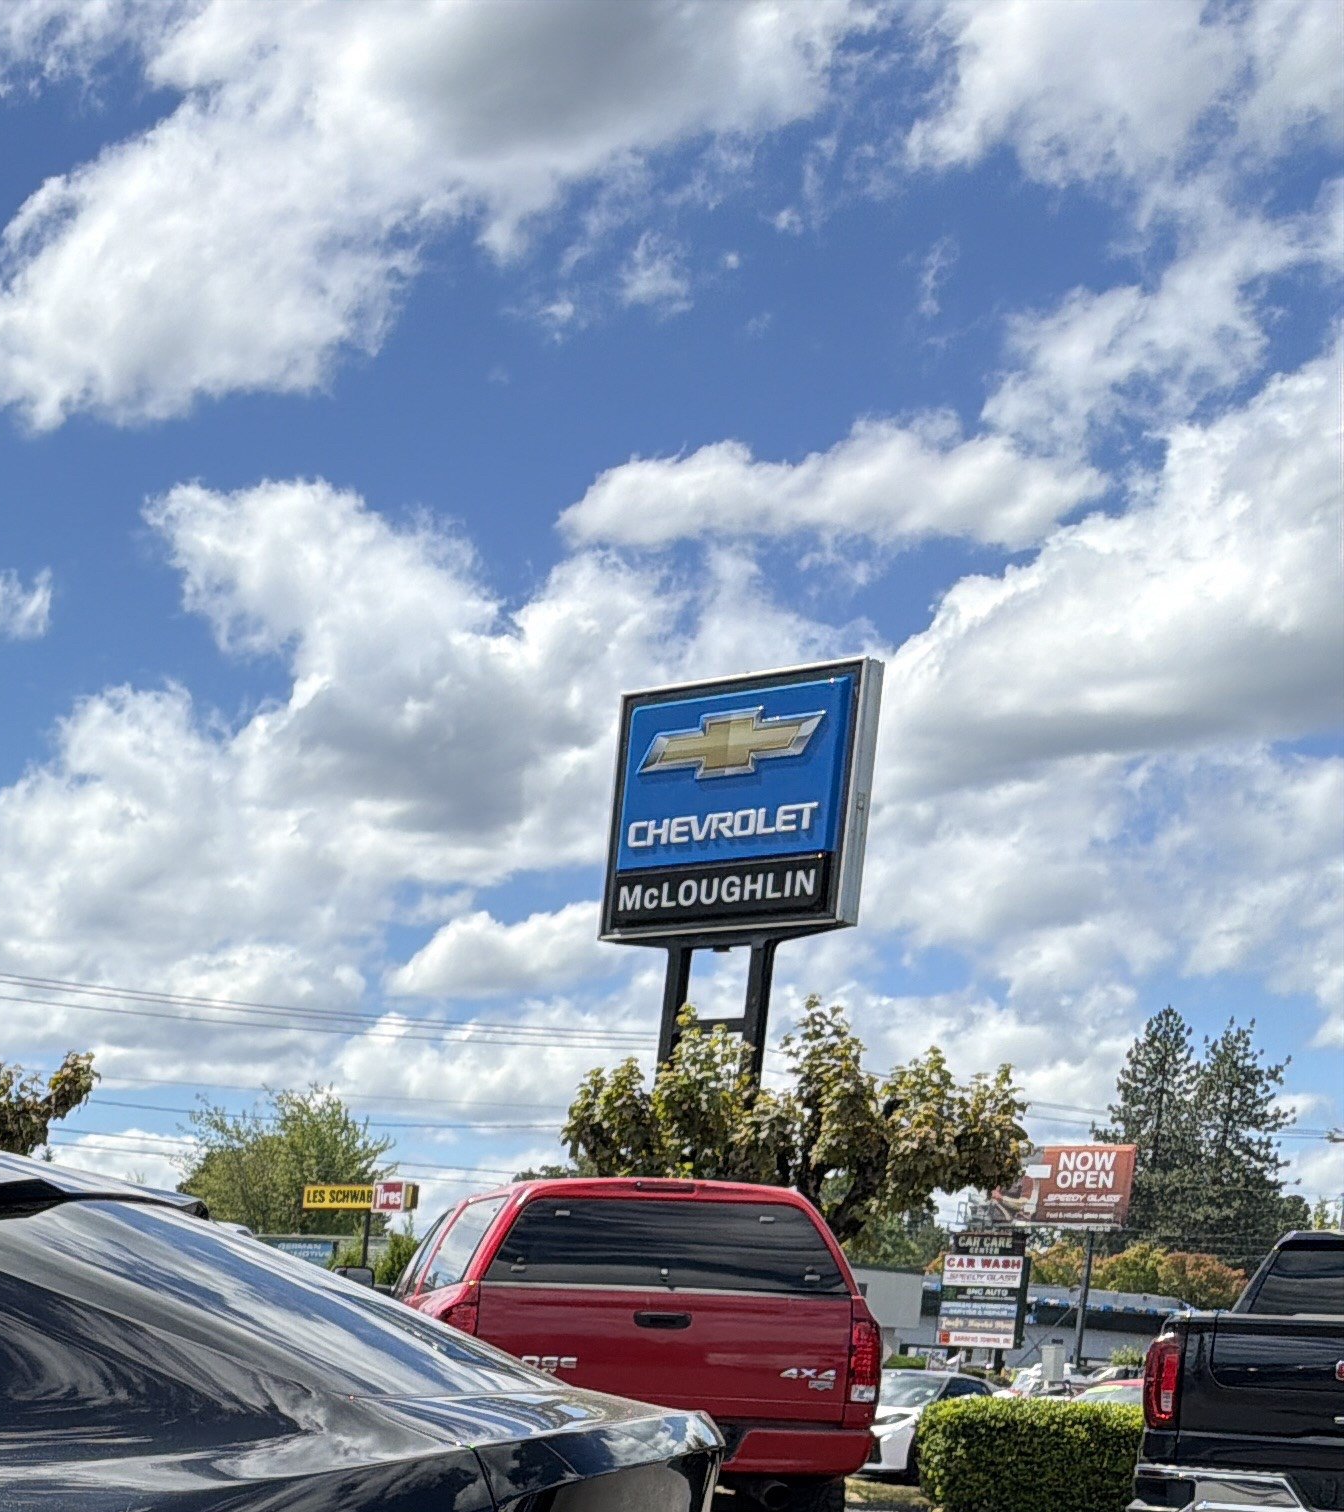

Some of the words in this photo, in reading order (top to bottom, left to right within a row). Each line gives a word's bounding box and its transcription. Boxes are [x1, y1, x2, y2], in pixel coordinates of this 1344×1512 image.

[627, 802, 819, 849] CHEVROLET
[617, 868, 817, 912] McLOUGHLIN
[1058, 1151, 1117, 1171] NOW
[1056, 1170, 1115, 1189] OPEN
[306, 1190, 326, 1203] LES
[328, 1189, 373, 1204] SCHWAB
[375, 1184, 402, 1209] Tires
[958, 1236, 981, 1248] CAR
[983, 1236, 1012, 1249] CARE
[946, 1257, 976, 1269] CAR
[981, 1258, 1021, 1269] WASH
[985, 1288, 1009, 1297] AUTO
